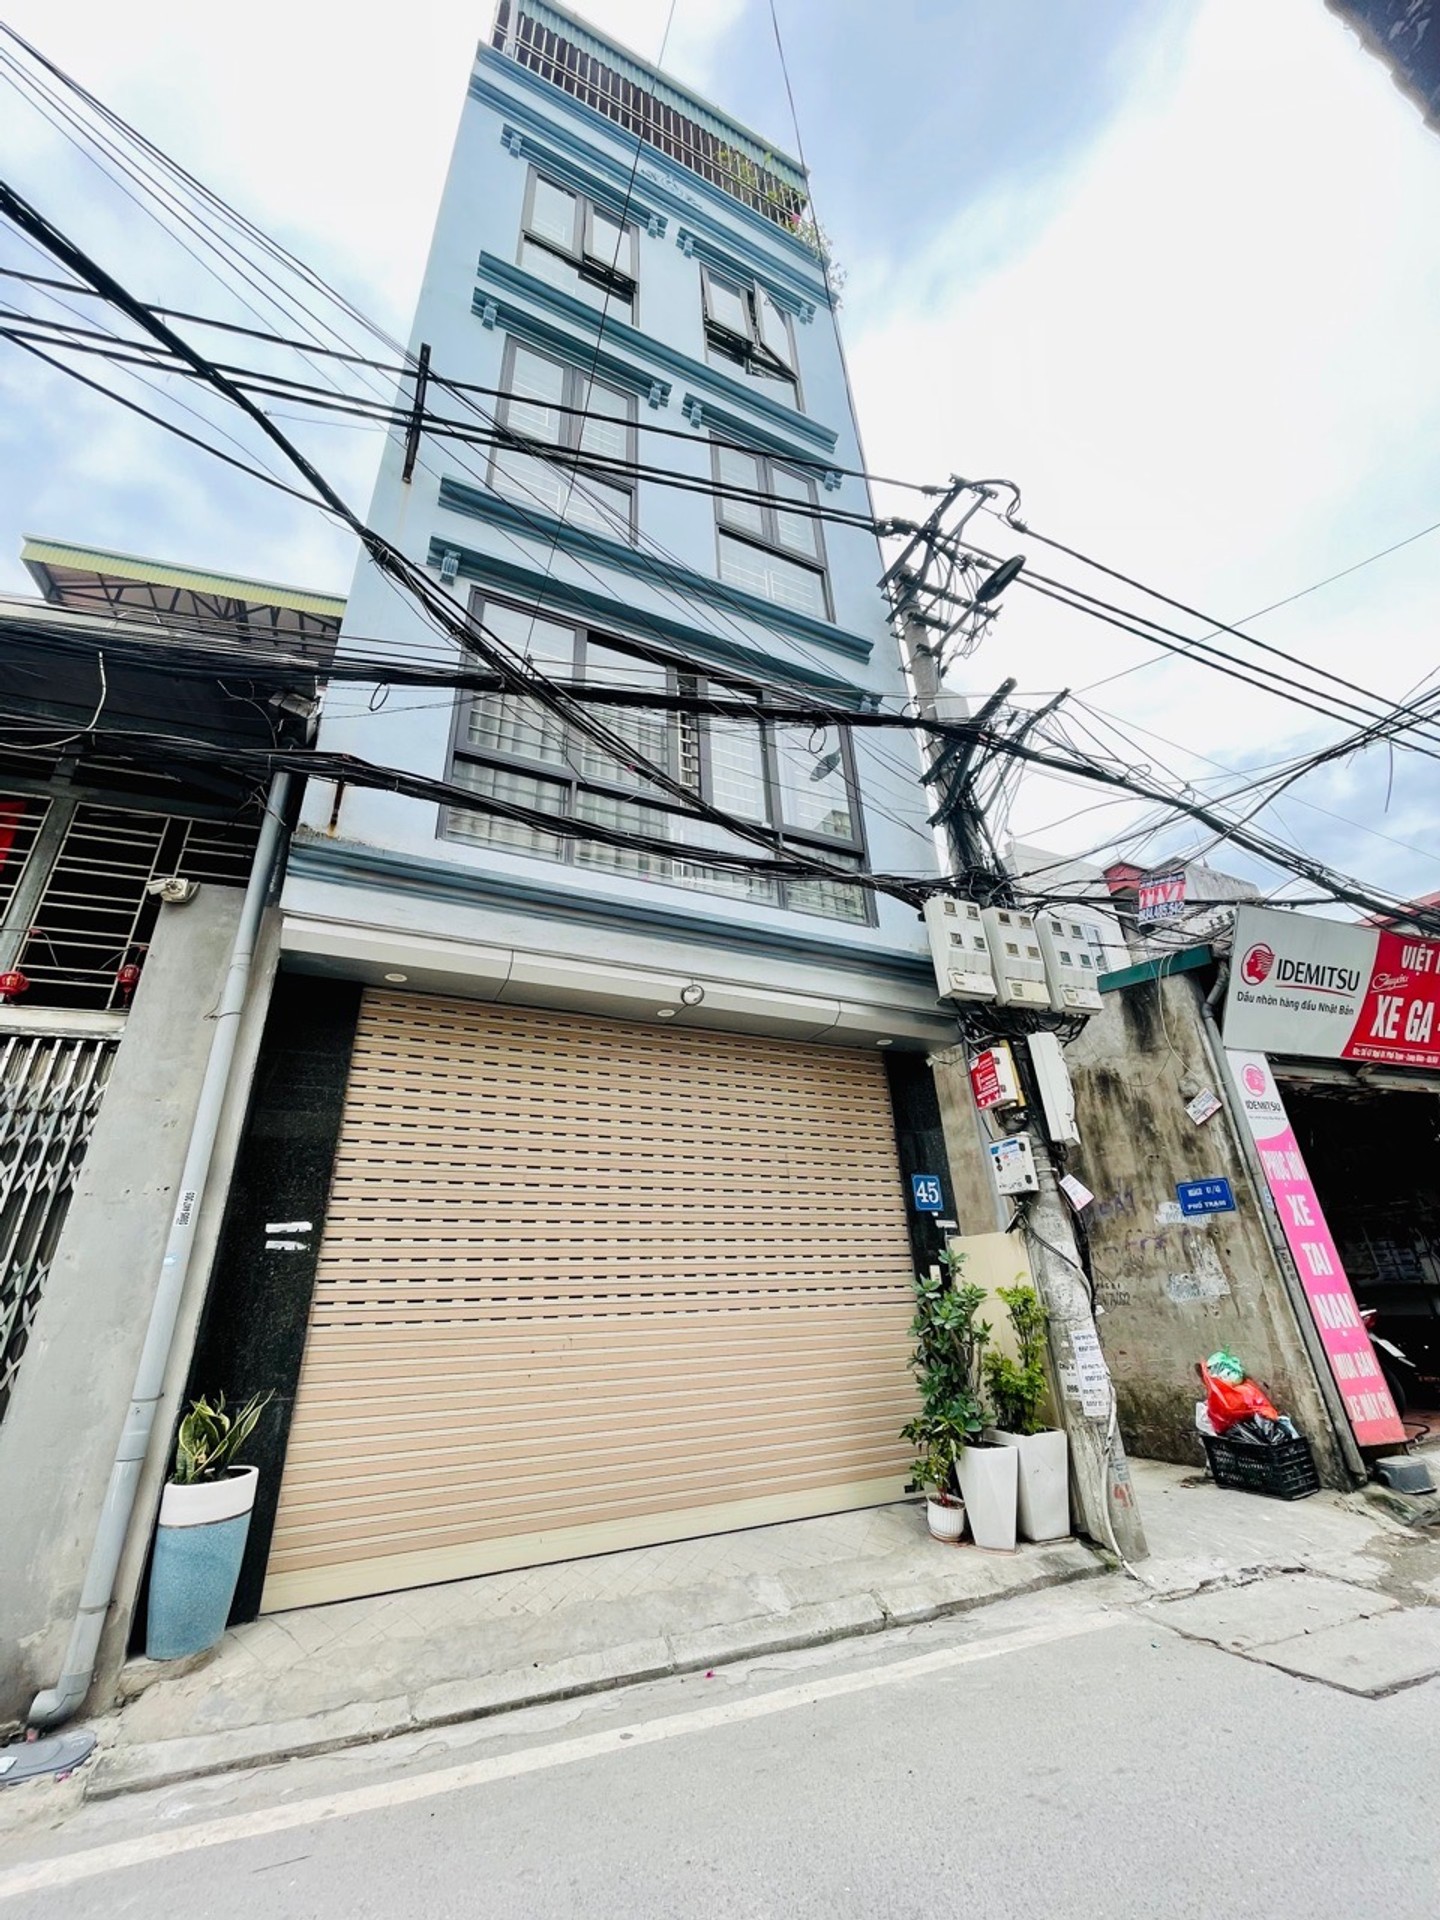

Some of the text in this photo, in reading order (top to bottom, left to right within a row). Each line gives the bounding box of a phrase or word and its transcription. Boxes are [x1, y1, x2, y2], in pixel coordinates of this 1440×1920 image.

[1276, 958, 1361, 991] IDEMITSU
[1401, 943, 1434, 976] VIỆT
[1280, 997, 1300, 1011] hàng
[1370, 994, 1435, 1043] XE GA
[917, 1181, 939, 1203] 45
[1187, 1201, 1203, 1210] PHỐ
[1286, 1194, 1316, 1227] XE
[1300, 1242, 1334, 1276] TAI
[1313, 1292, 1360, 1338] NẠN
